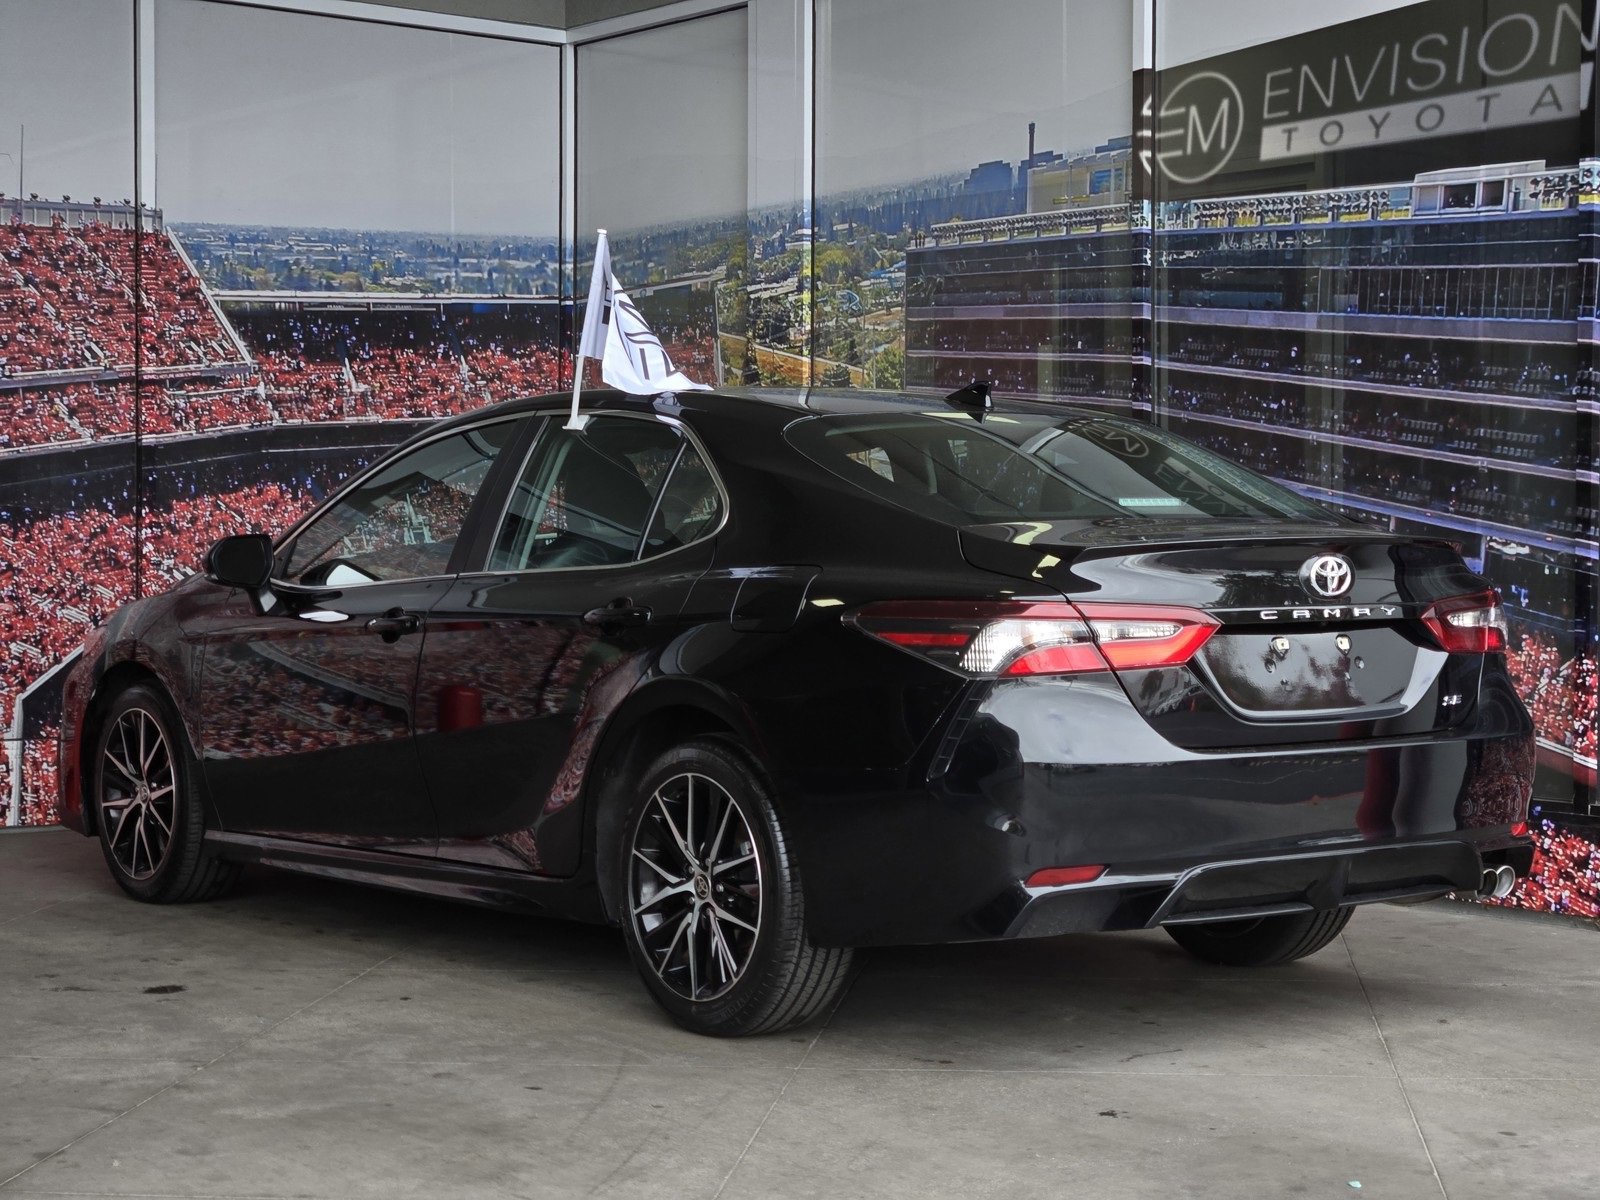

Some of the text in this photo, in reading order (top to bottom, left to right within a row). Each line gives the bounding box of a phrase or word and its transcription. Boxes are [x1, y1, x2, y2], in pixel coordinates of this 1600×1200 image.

[1262, 0, 1598, 120] ENVISION
[1281, 83, 1562, 152] TOYOTA
[1259, 605, 1397, 620] CAMRY
